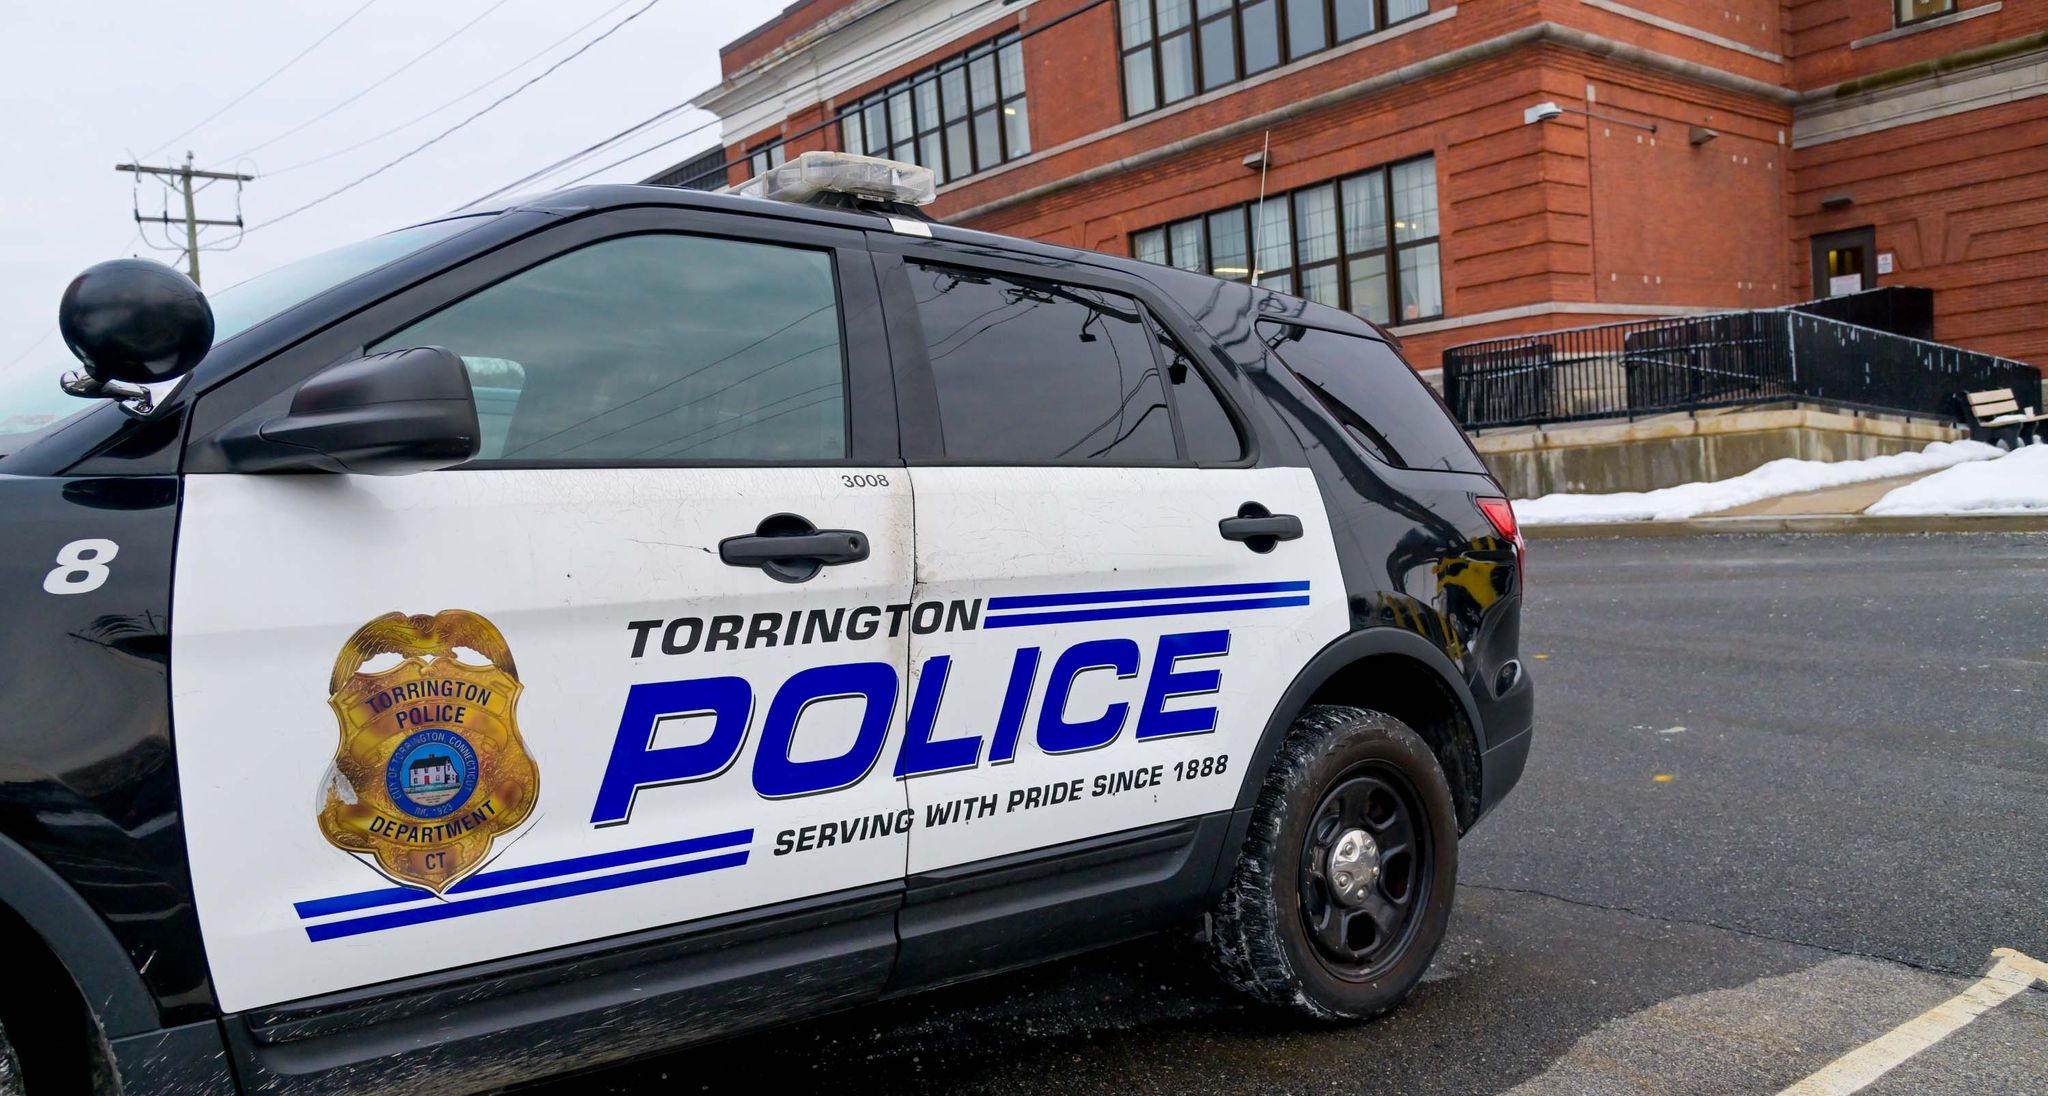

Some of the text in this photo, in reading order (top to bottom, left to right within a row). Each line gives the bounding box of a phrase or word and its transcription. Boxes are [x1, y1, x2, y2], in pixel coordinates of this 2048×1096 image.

[841, 474, 890, 488] 3008
[42, 538, 120, 596] 8
[626, 598, 983, 660] TORRINGTON
[364, 679, 492, 714] TORRINGTON
[395, 704, 466, 729] POLICE
[589, 629, 1231, 829] POLICE
[368, 799, 496, 843] DEPARTMENT
[773, 754, 1230, 857] SERVING WITH PRIDE SINCE 1888
[425, 852, 446, 870] CT
